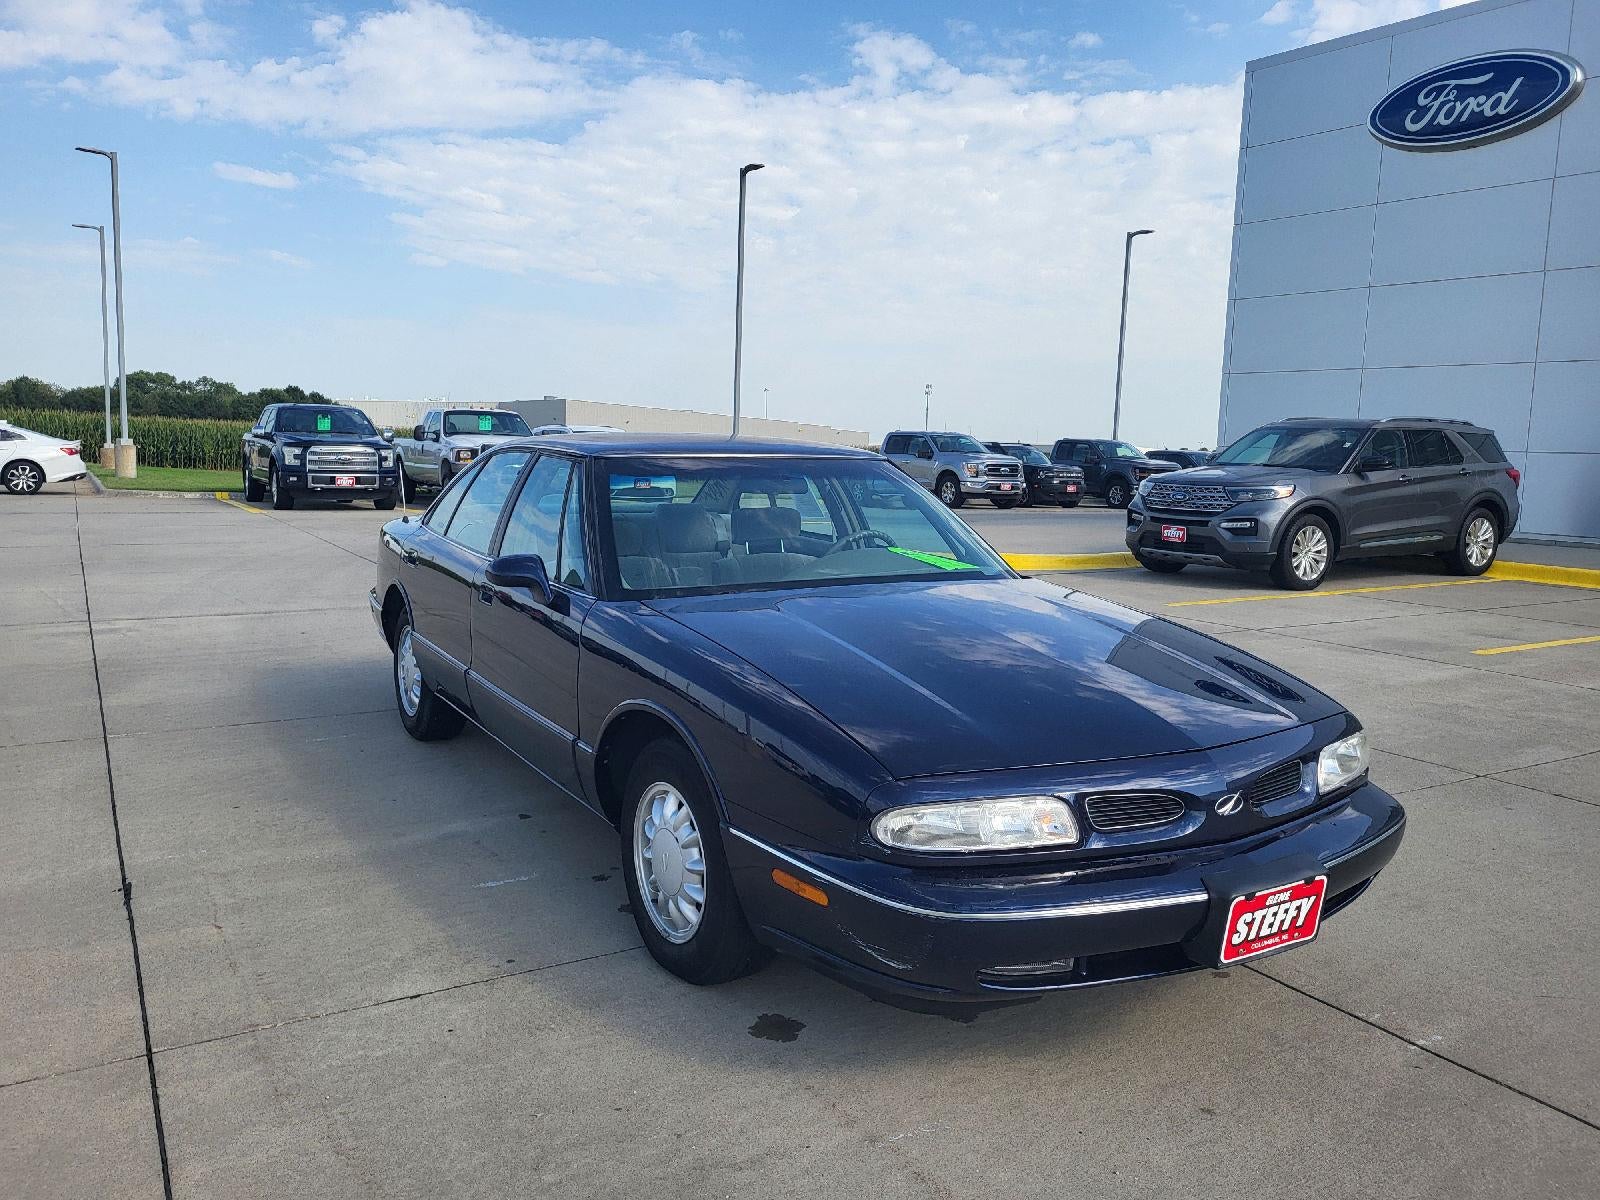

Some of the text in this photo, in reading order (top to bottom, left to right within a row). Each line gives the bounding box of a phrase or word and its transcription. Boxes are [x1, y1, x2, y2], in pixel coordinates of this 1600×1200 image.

[1404, 71, 1525, 132] Ford
[1163, 529, 1184, 538] STEFFY
[1265, 890, 1293, 906] GENE
[1231, 895, 1317, 945] STEFFY
